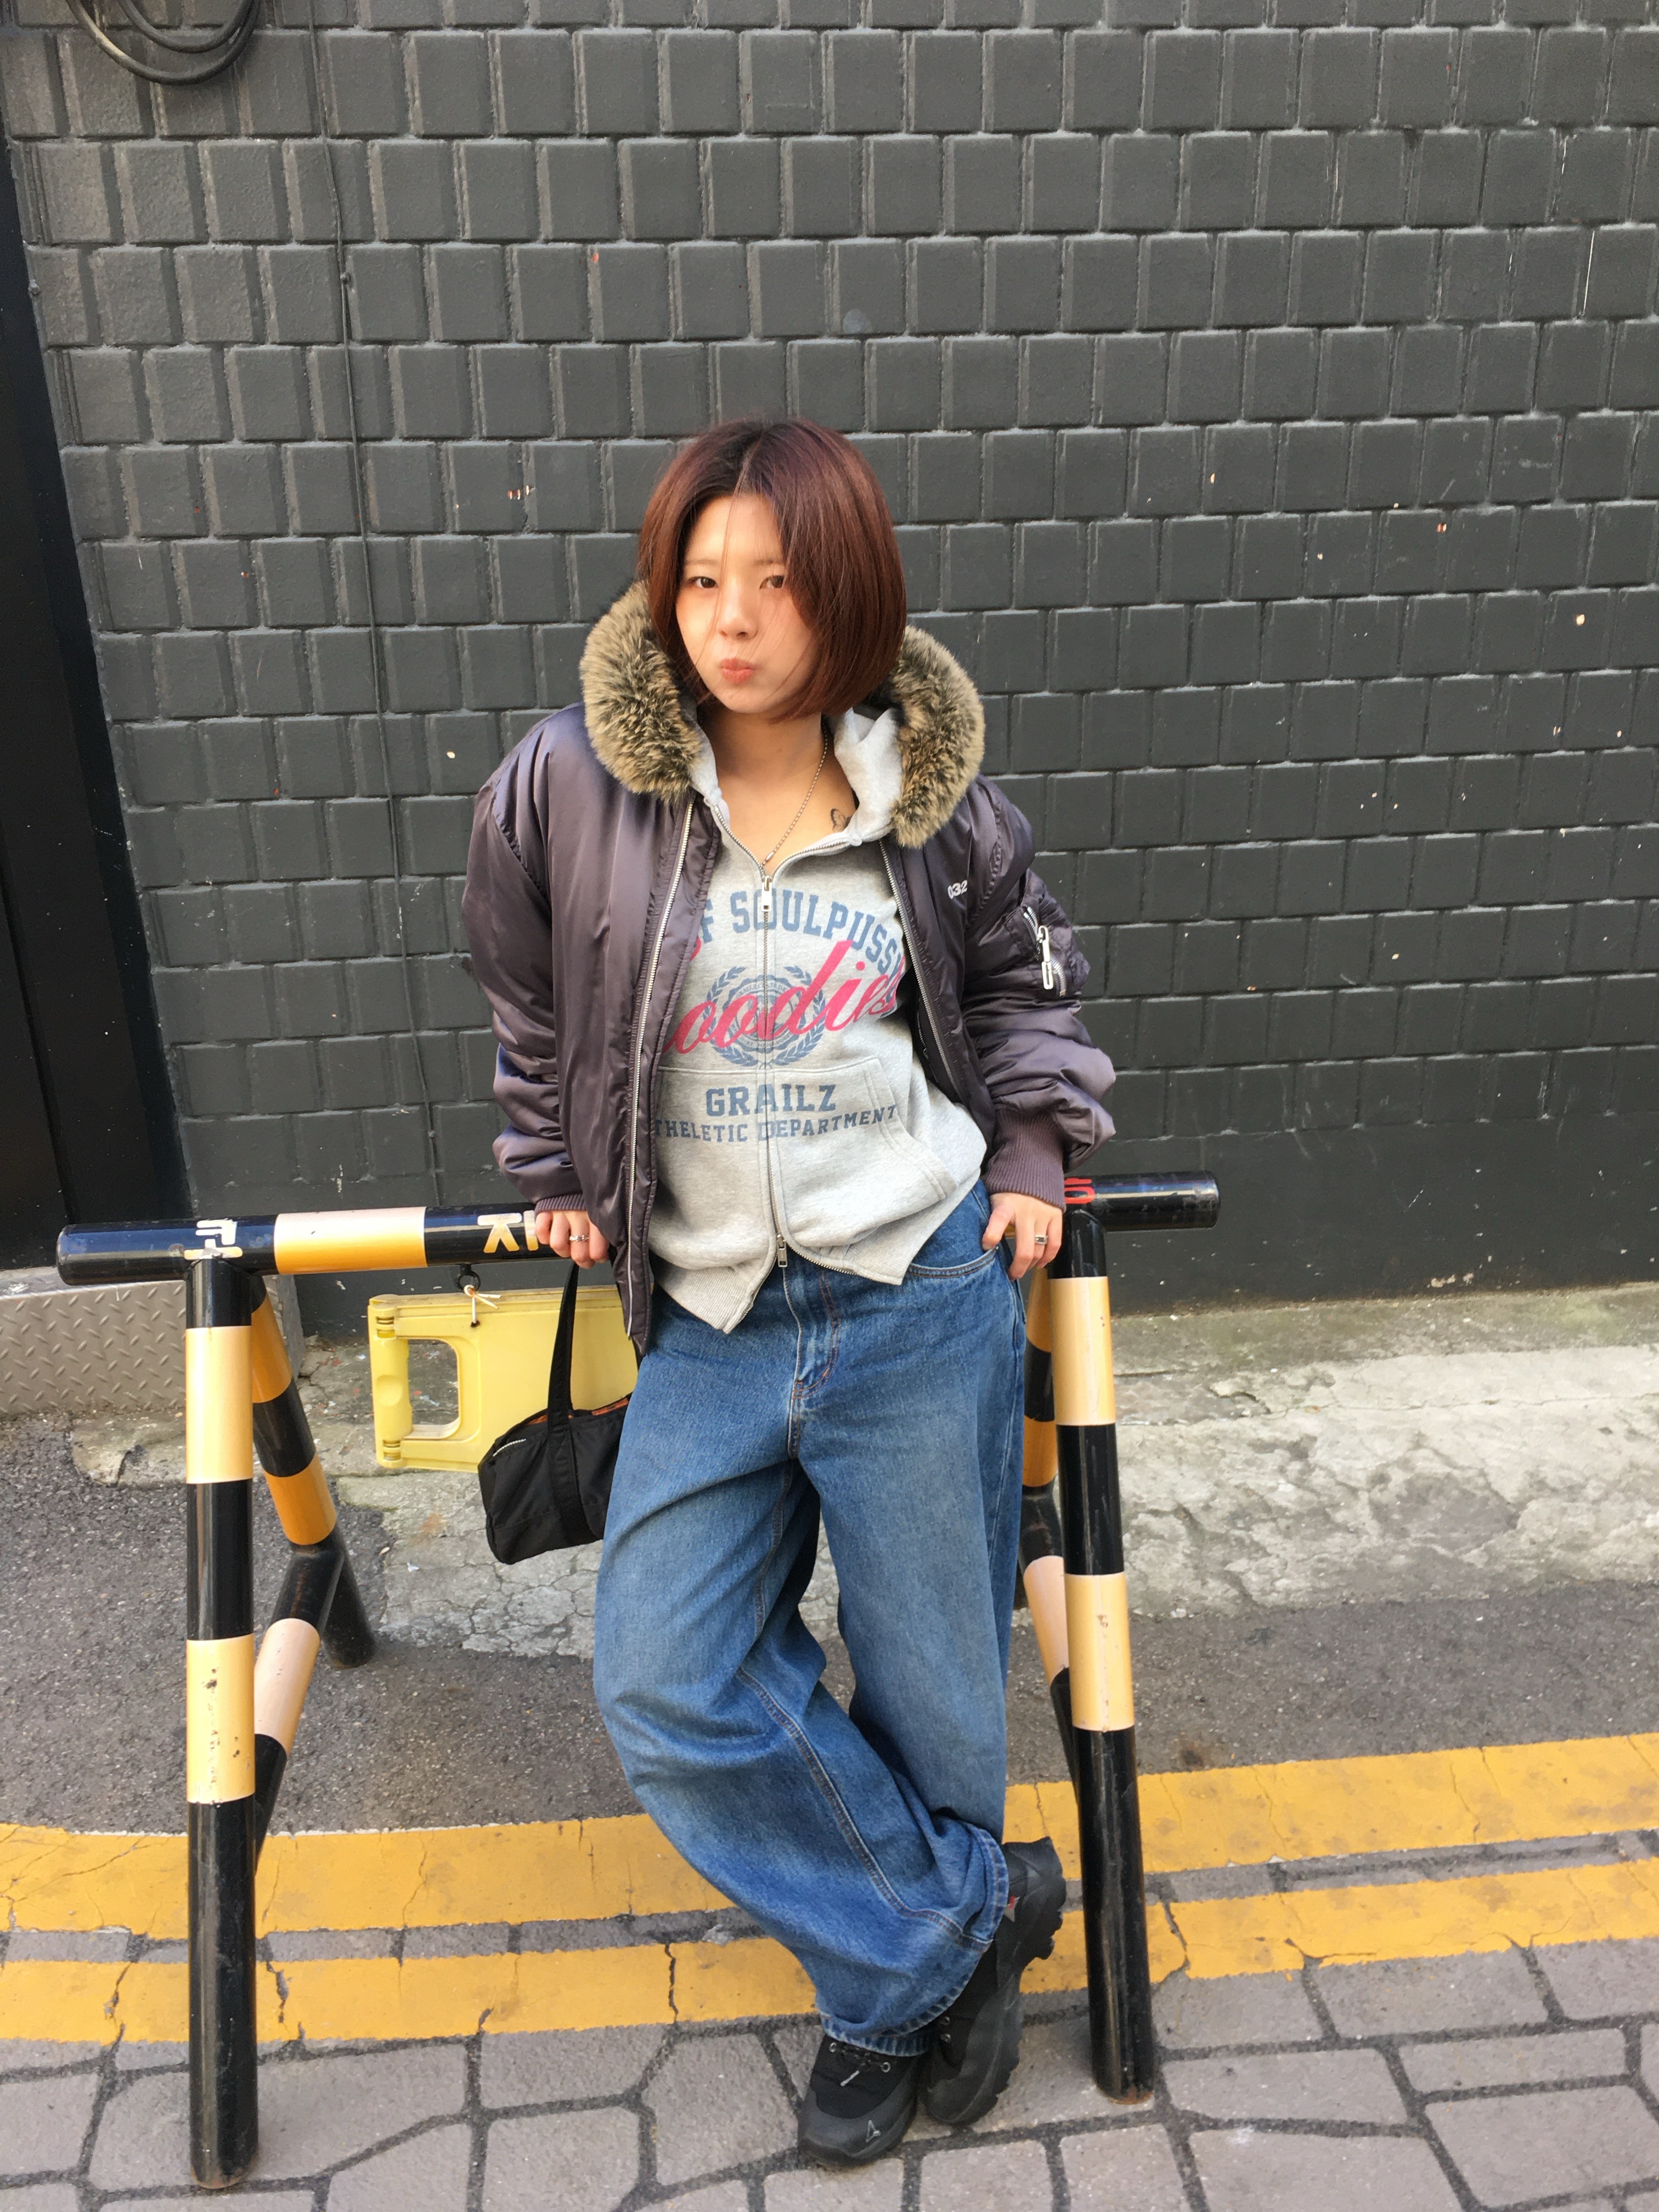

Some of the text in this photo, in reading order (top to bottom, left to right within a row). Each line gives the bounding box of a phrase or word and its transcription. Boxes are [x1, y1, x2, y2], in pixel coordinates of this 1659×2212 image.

[662, 939, 906, 1054] oodies
[706, 1084, 836, 1117] GRAILZ
[655, 1104, 897, 1143] THELETIC DEPARTMENT
